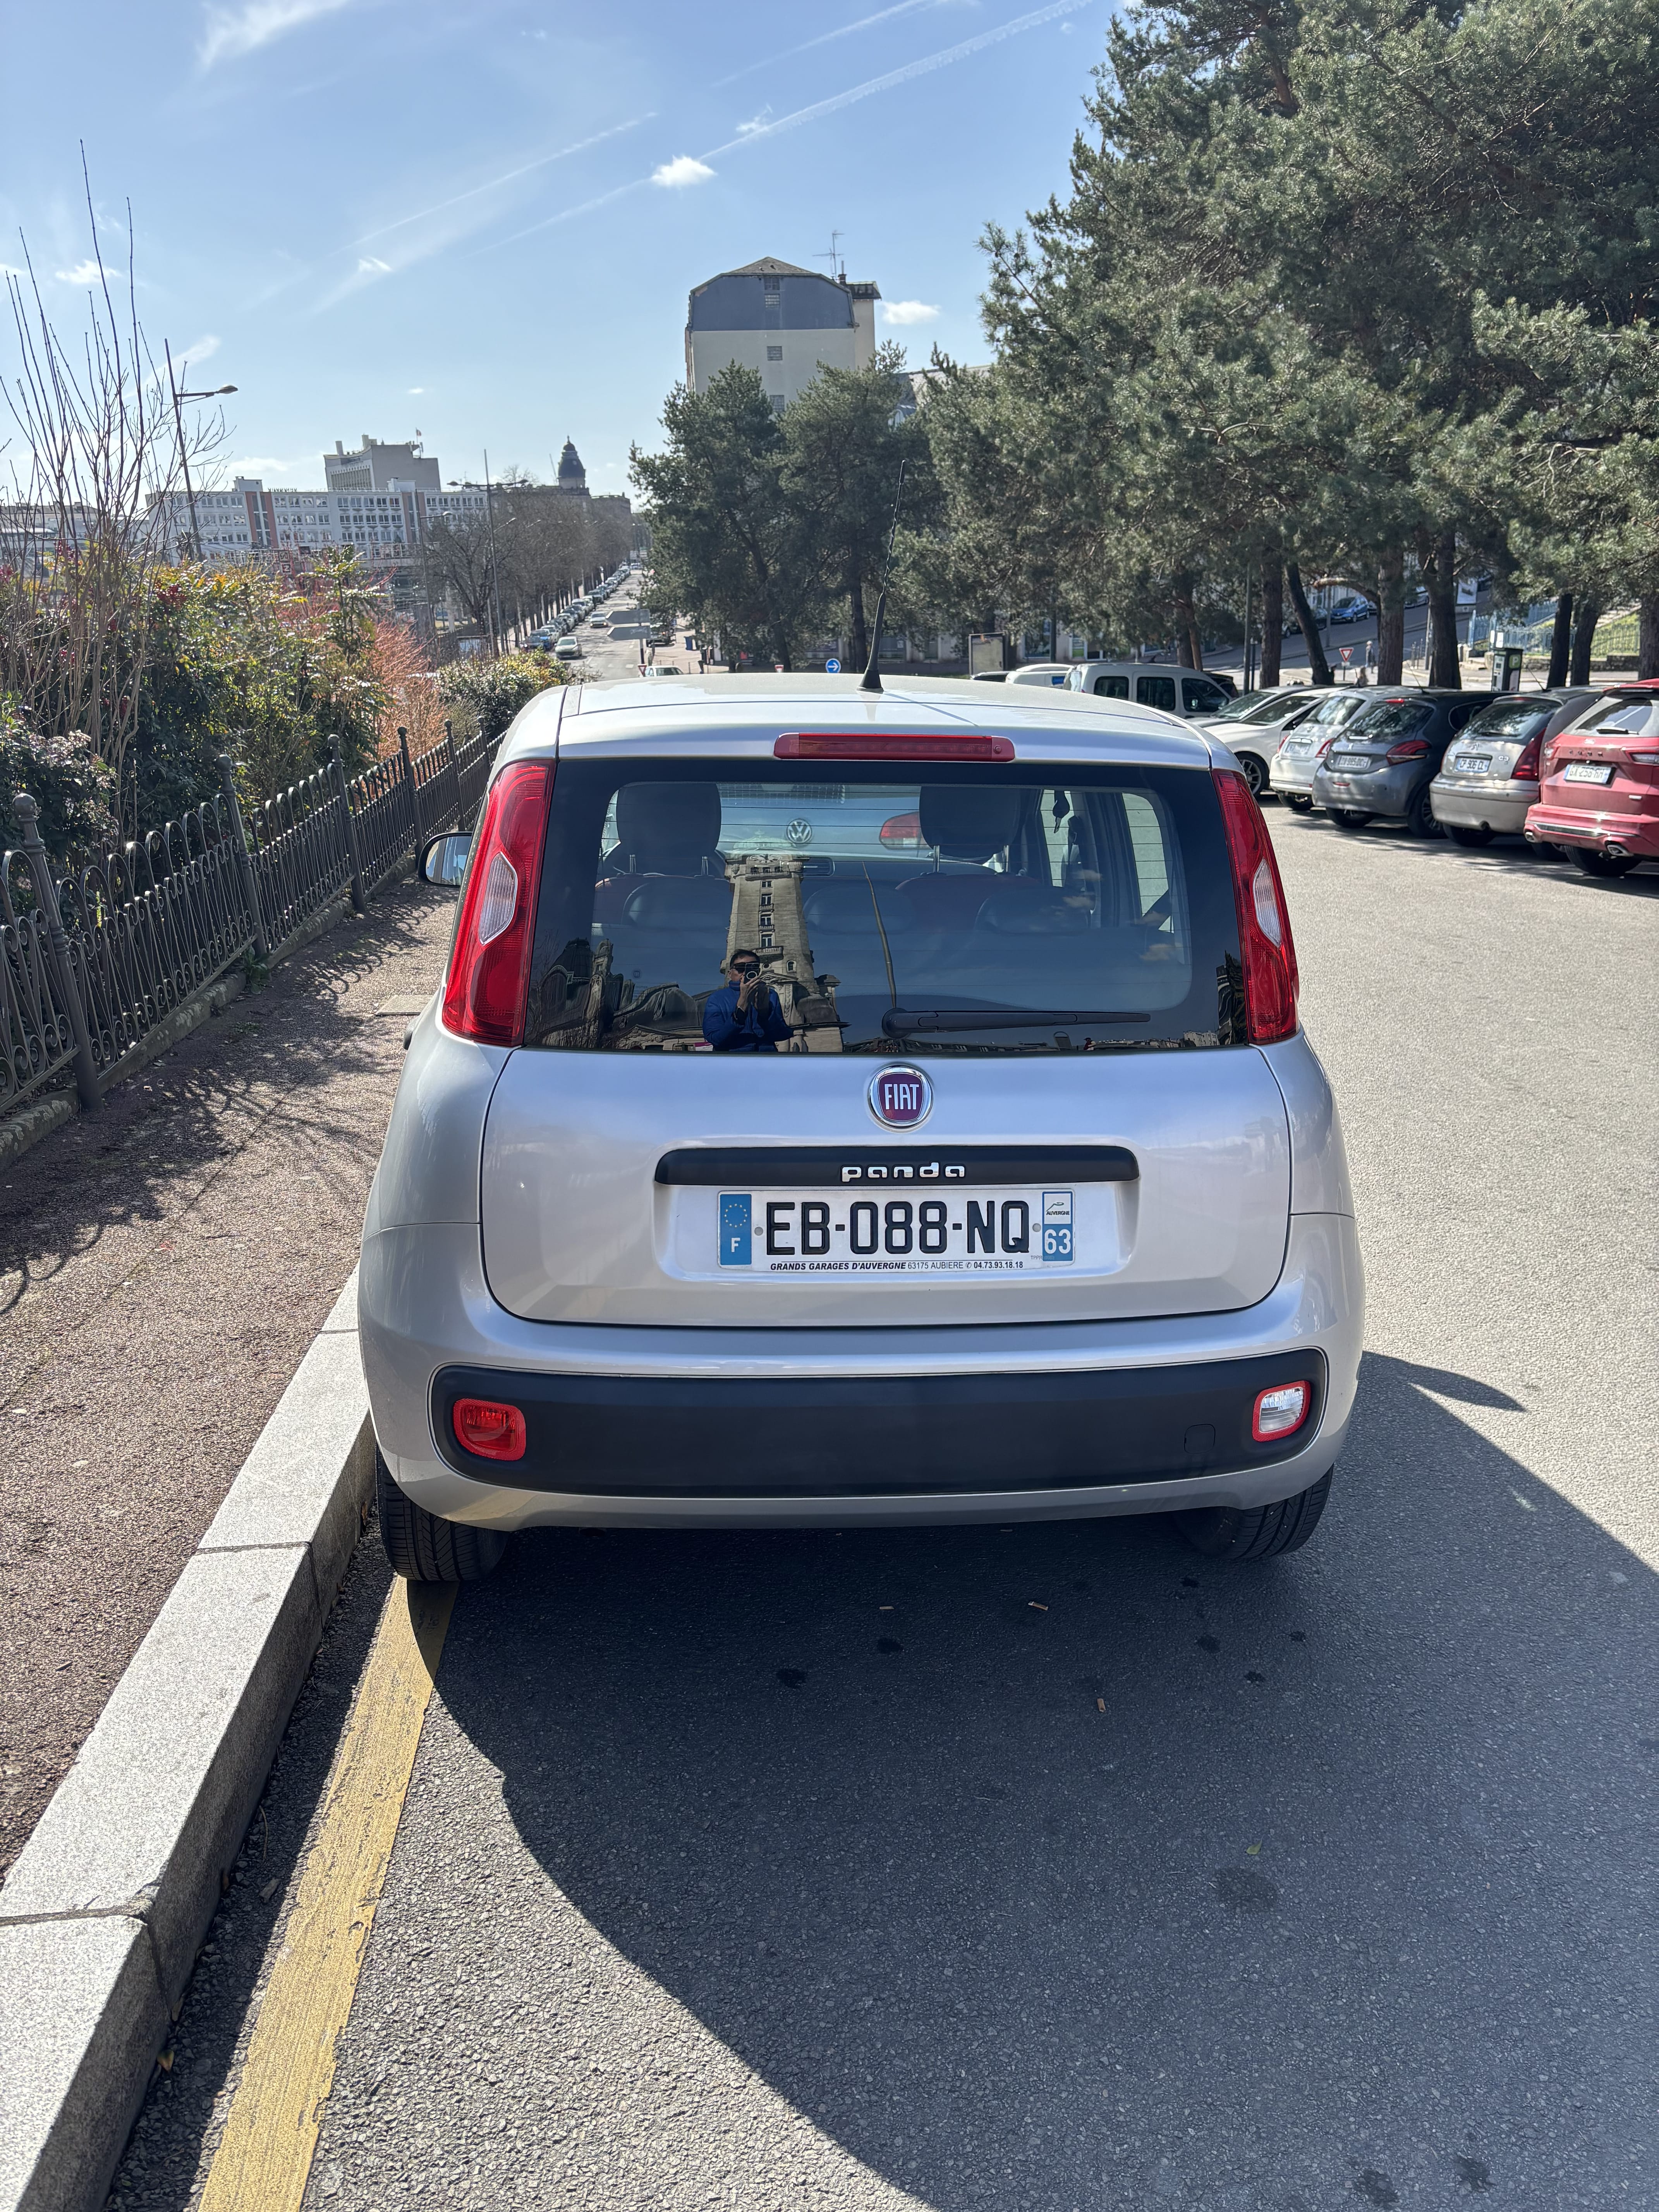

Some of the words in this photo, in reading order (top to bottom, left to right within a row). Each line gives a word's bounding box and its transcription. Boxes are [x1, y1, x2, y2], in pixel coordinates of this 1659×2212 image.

[1512, 656, 1519, 666] P
[884, 1084, 919, 1110] FIAT
[842, 1162, 965, 1182] panda
[766, 1200, 1029, 1255] EB-088-NQ
[731, 1237, 741, 1252] F
[1044, 1229, 1071, 1254] 63
